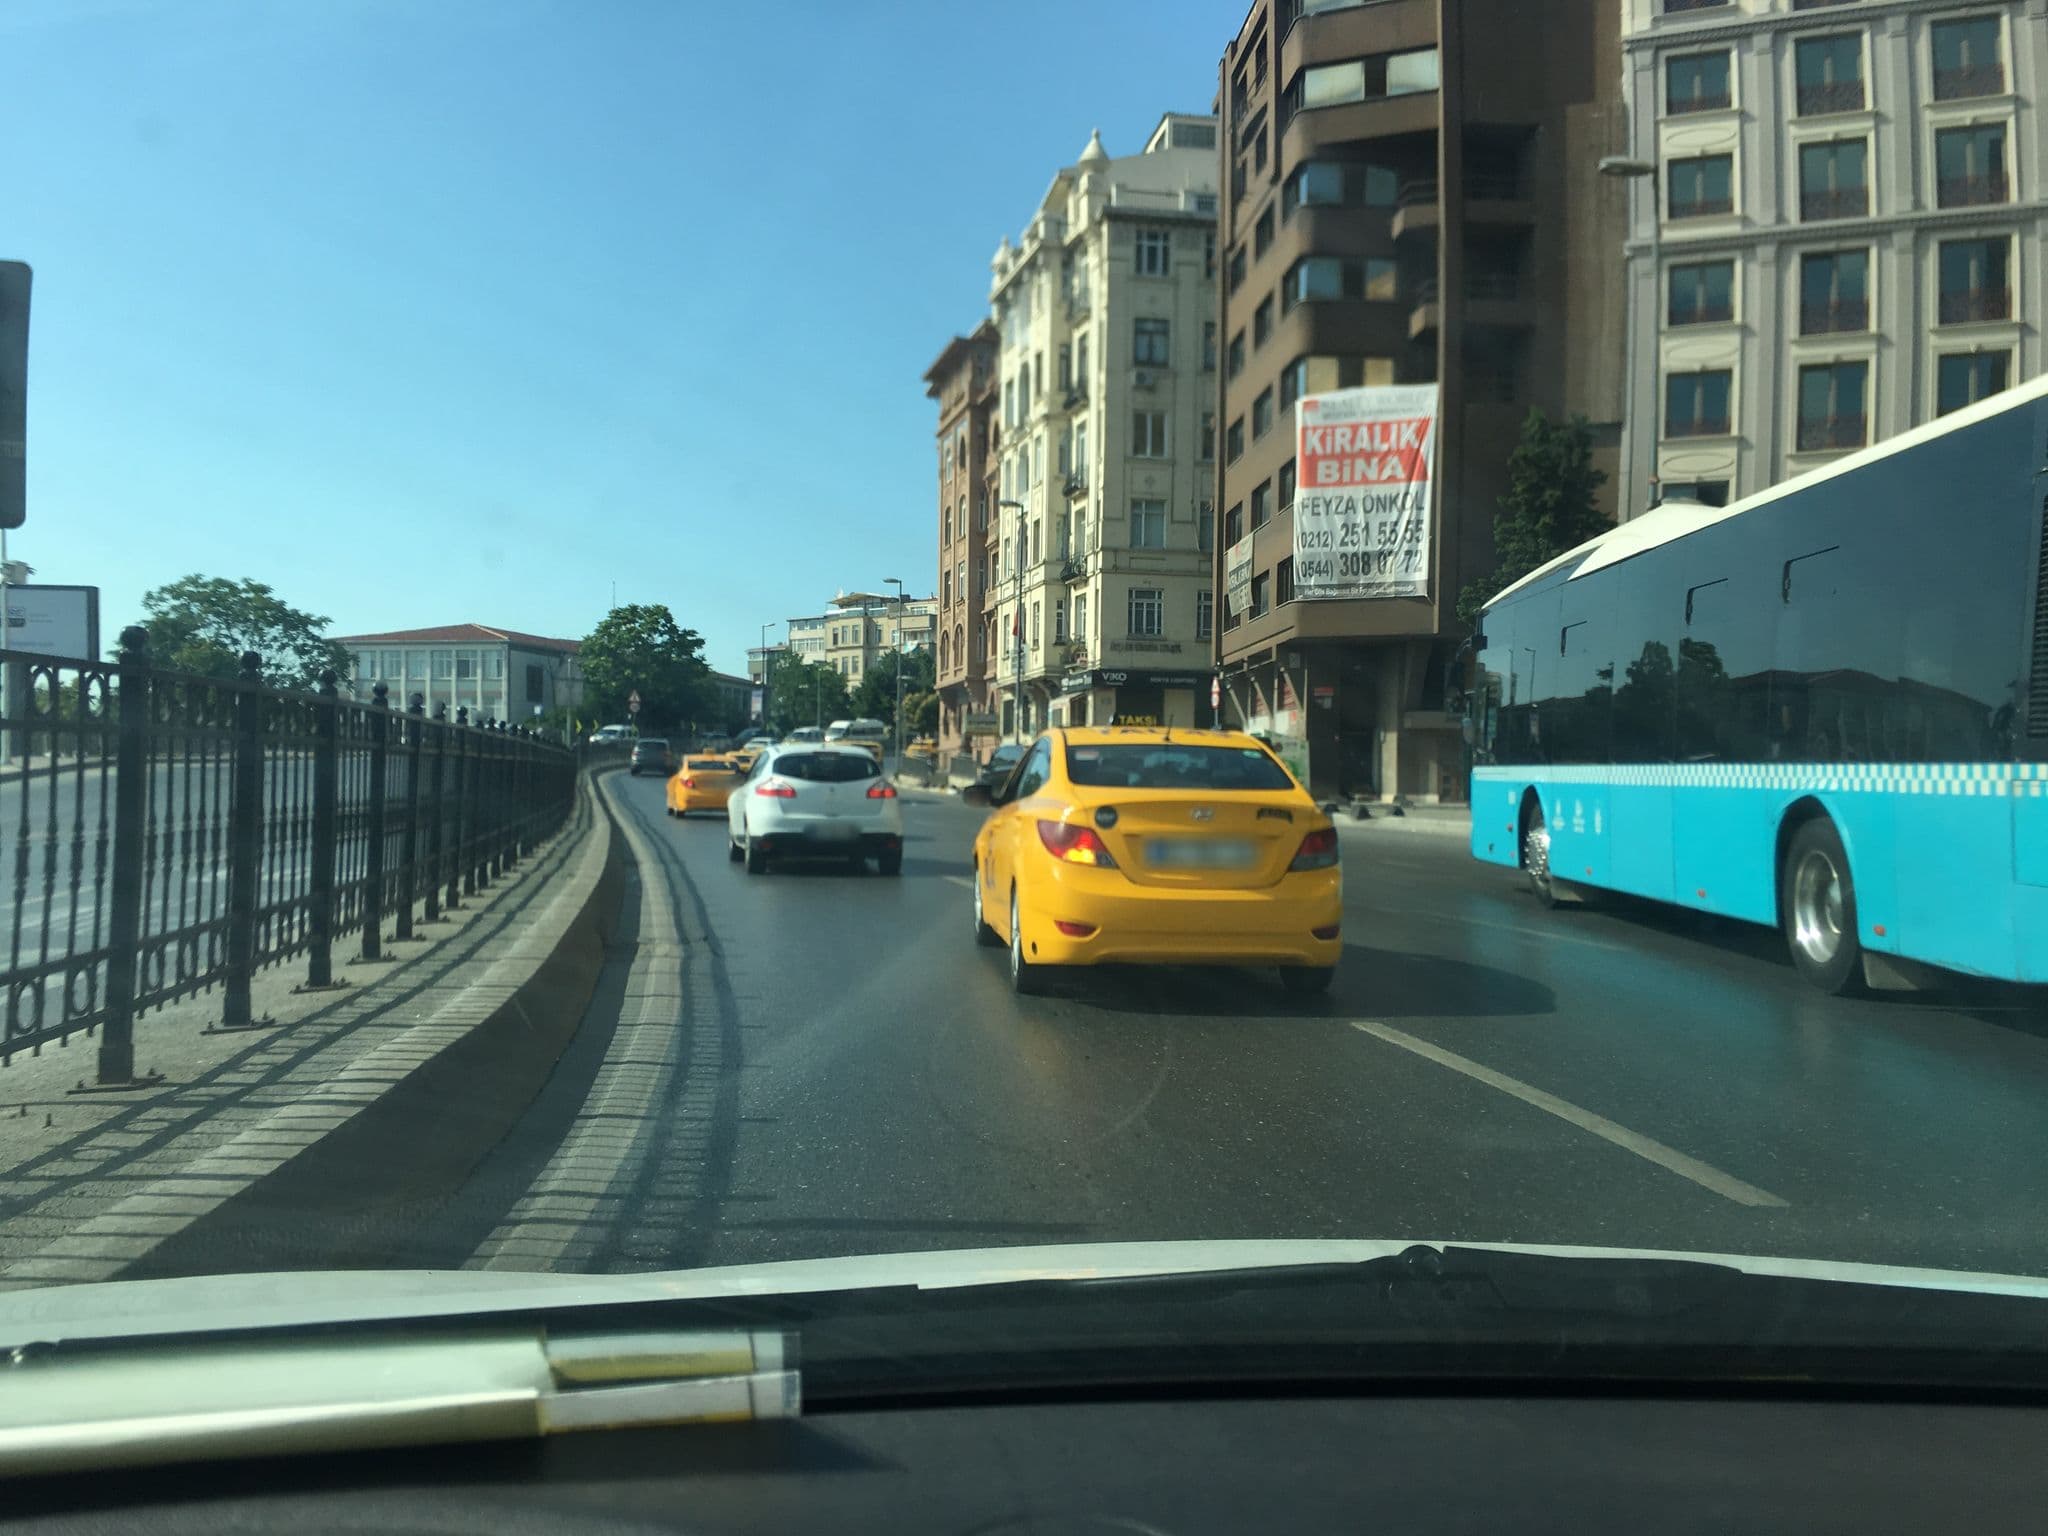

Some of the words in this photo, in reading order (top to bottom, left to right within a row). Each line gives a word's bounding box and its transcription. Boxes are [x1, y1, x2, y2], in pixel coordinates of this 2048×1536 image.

[1301, 496, 1356, 516] FEYZA
[1296, 530, 1333, 552] (0212)
[1339, 522, 1370, 547] 251
[1295, 558, 1333, 582] (0544)
[1339, 552, 1371, 576] 308
